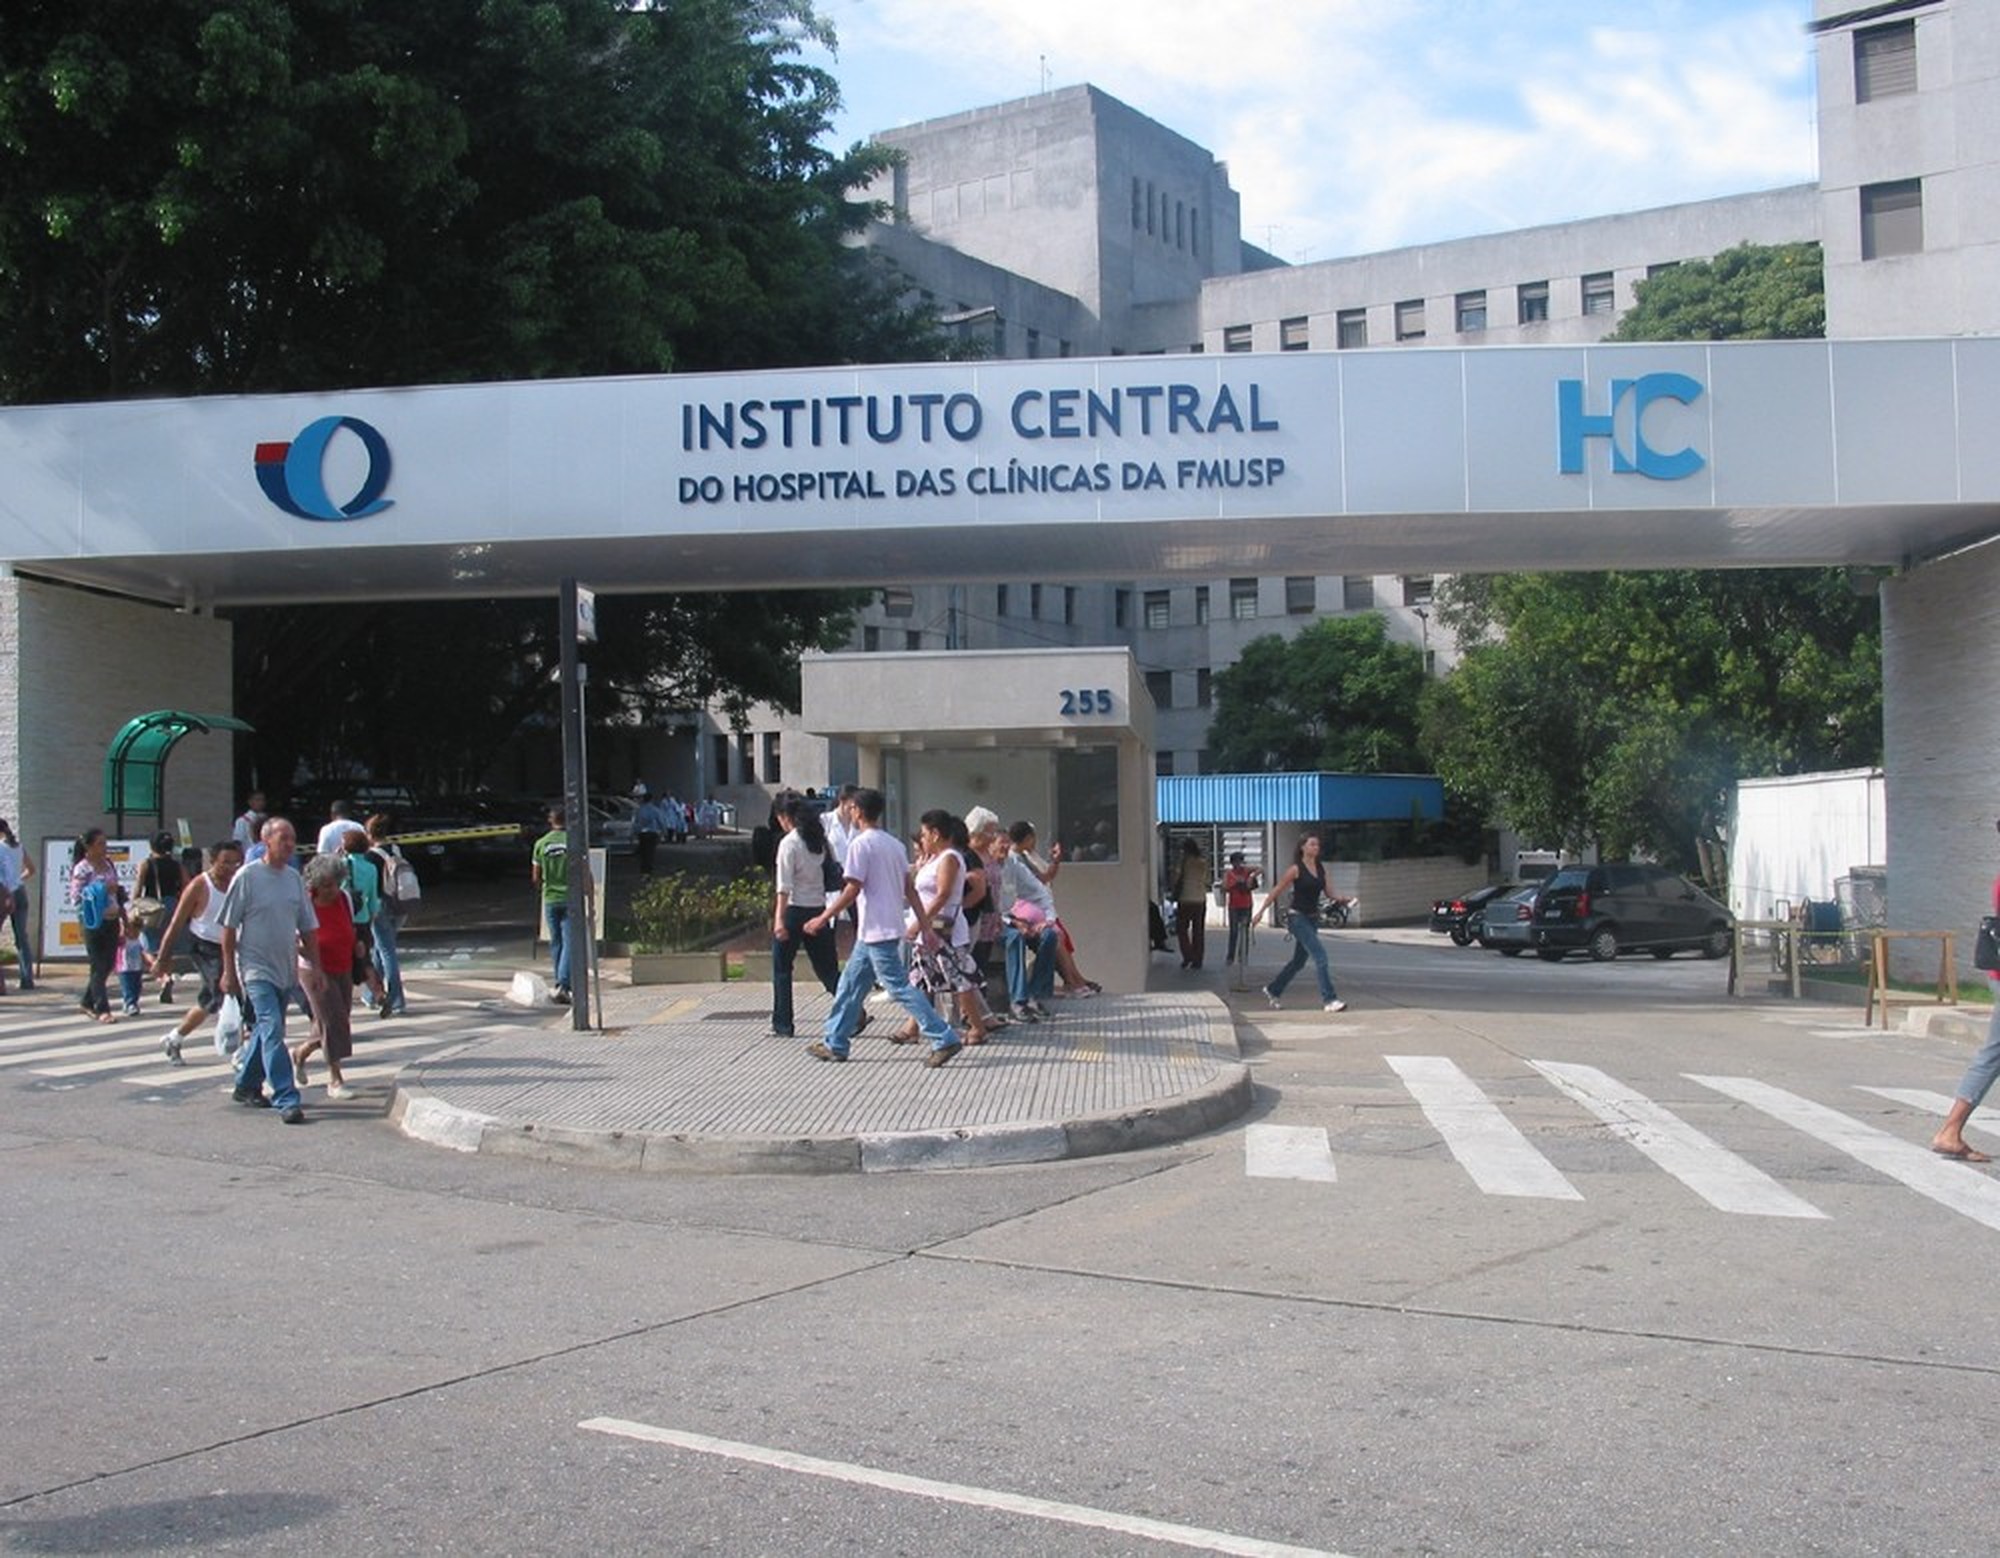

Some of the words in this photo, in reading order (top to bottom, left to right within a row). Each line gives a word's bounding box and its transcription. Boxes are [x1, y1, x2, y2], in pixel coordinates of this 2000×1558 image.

[683, 392, 983, 451] INSTITUTO
[1012, 384, 1279, 439] CENTRAL
[1558, 372, 1706, 481] HC
[679, 476, 725, 505] DO
[734, 470, 886, 504] HOSPITAL
[895, 468, 957, 499] DAS
[967, 458, 1112, 496] CLÍNICAS
[1121, 462, 1167, 491] DA
[1178, 458, 1286, 490] FMUSP
[1060, 689, 1112, 715] 255
